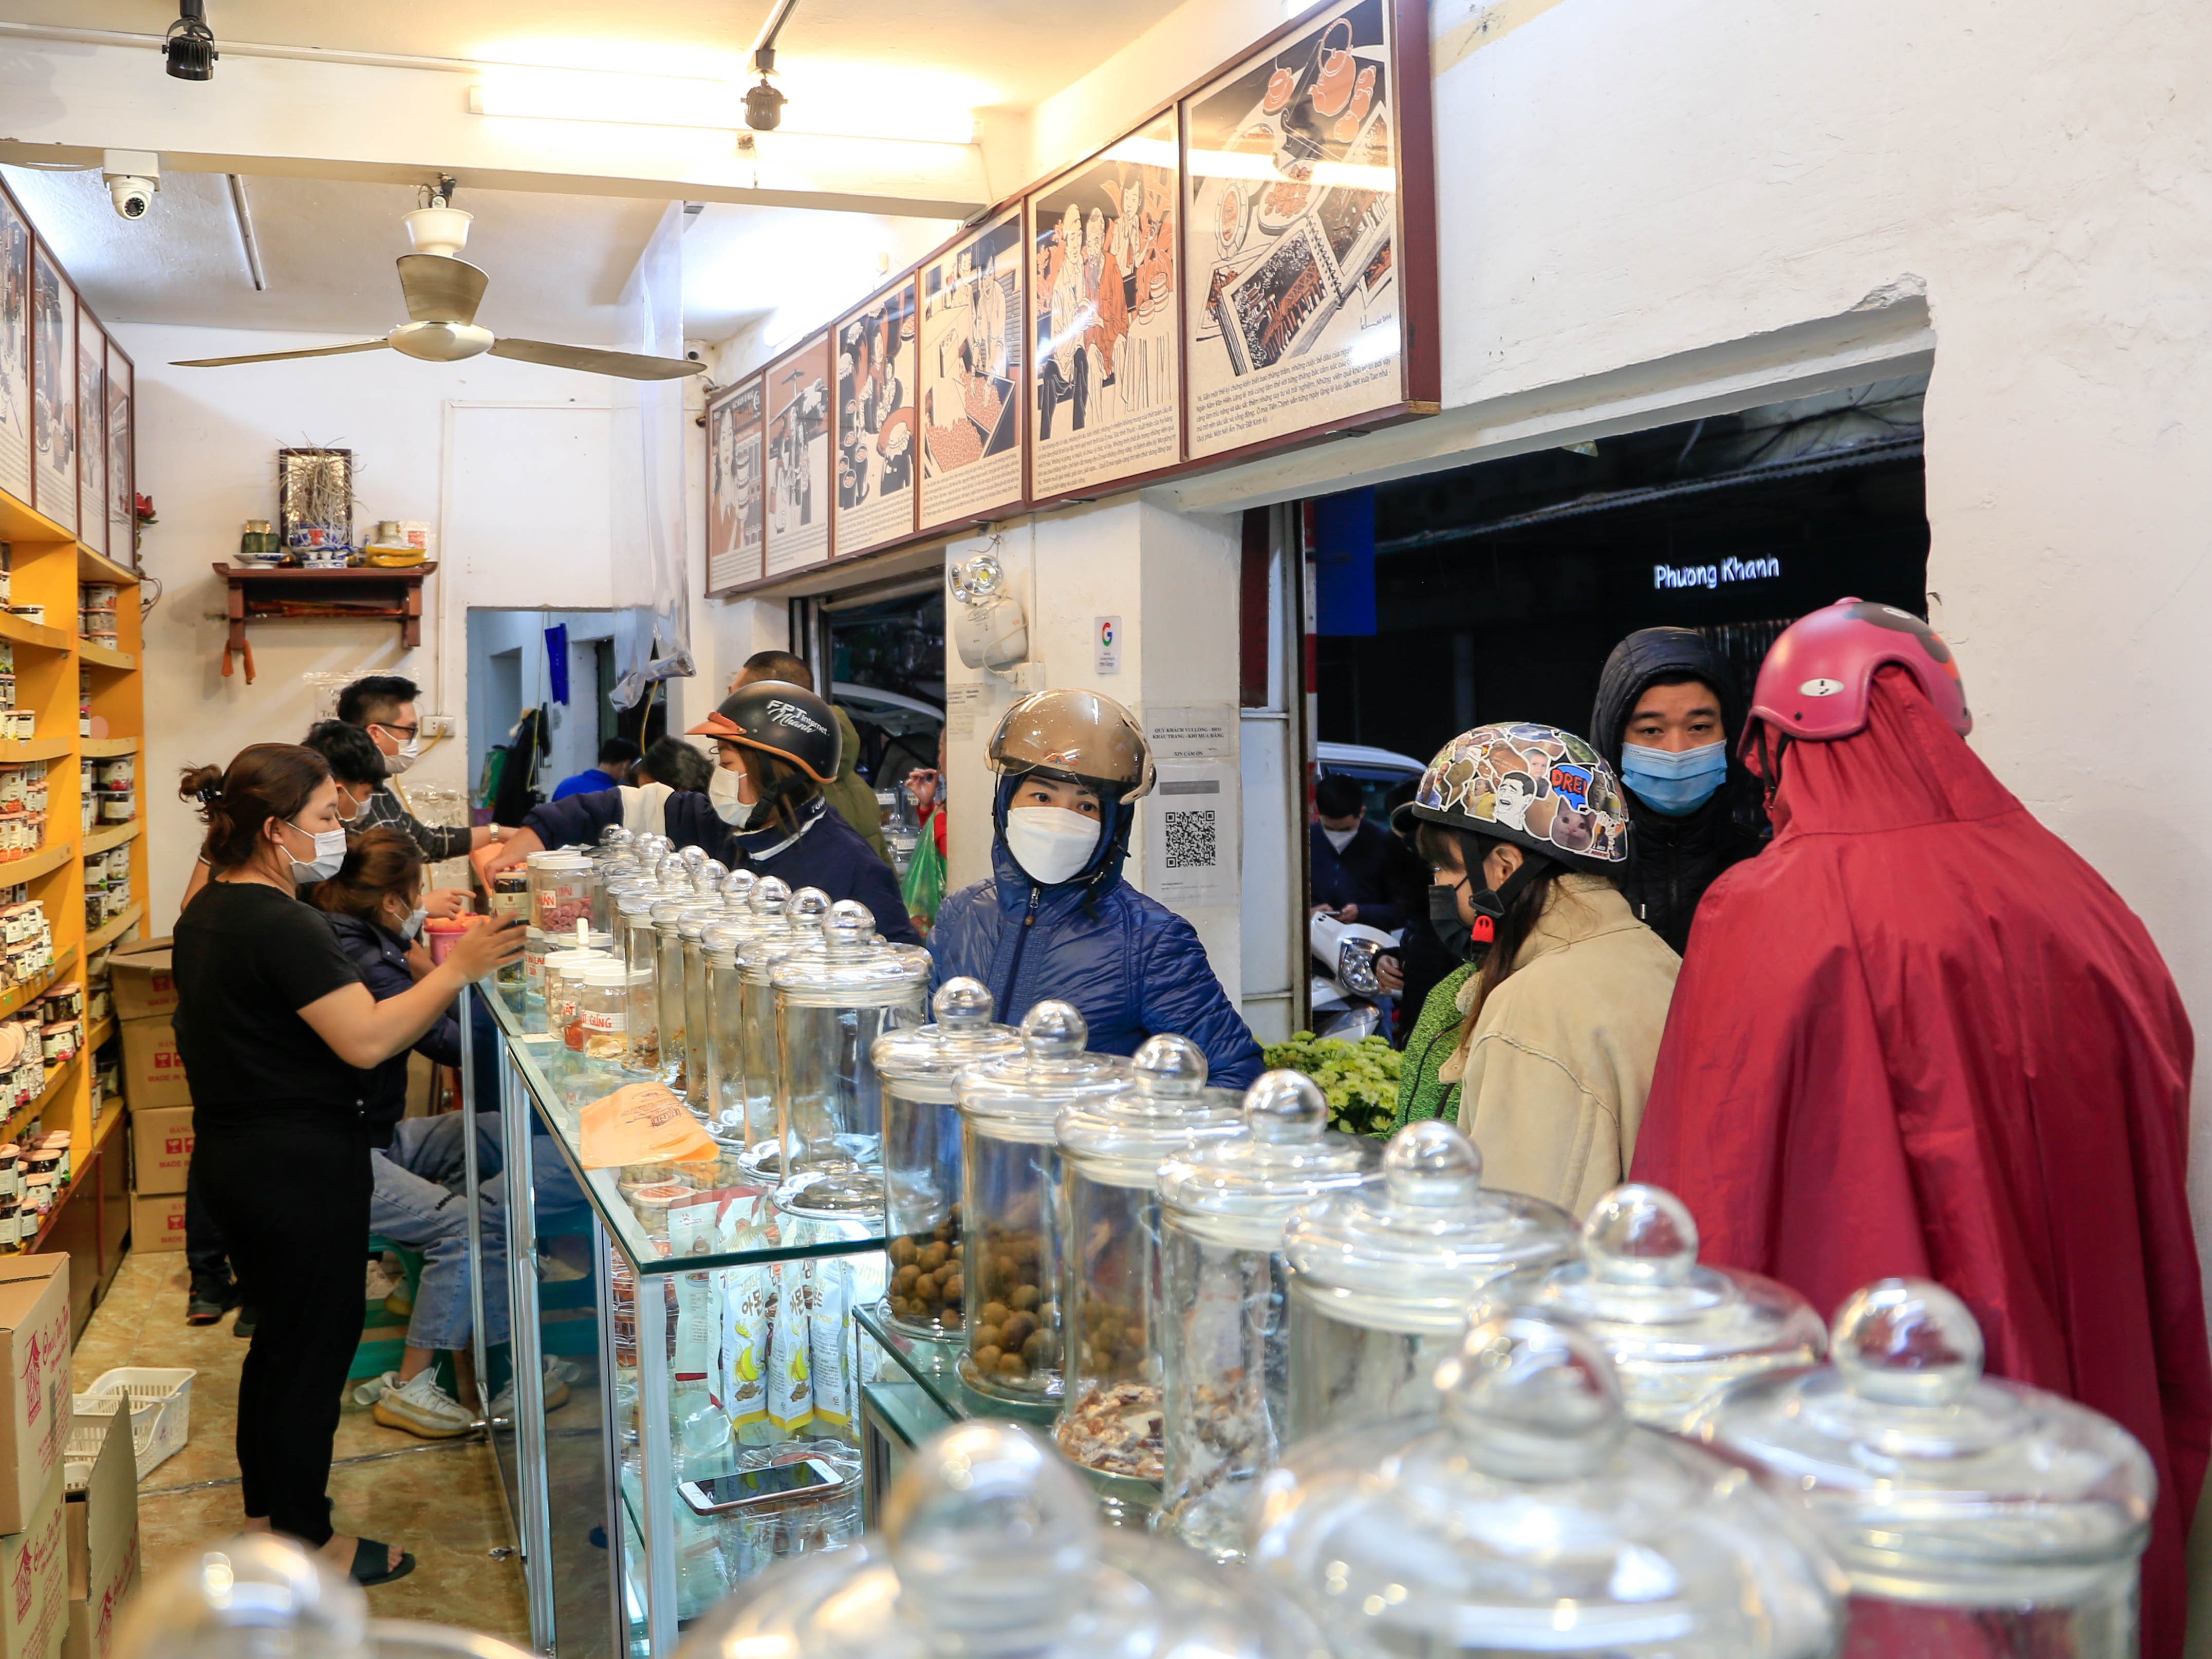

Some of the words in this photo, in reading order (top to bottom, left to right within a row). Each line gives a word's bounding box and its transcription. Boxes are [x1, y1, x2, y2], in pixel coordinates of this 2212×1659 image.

[767, 699, 807, 719] FPT
[802, 715, 828, 735] Internet
[768, 709, 816, 733] Nhanh
